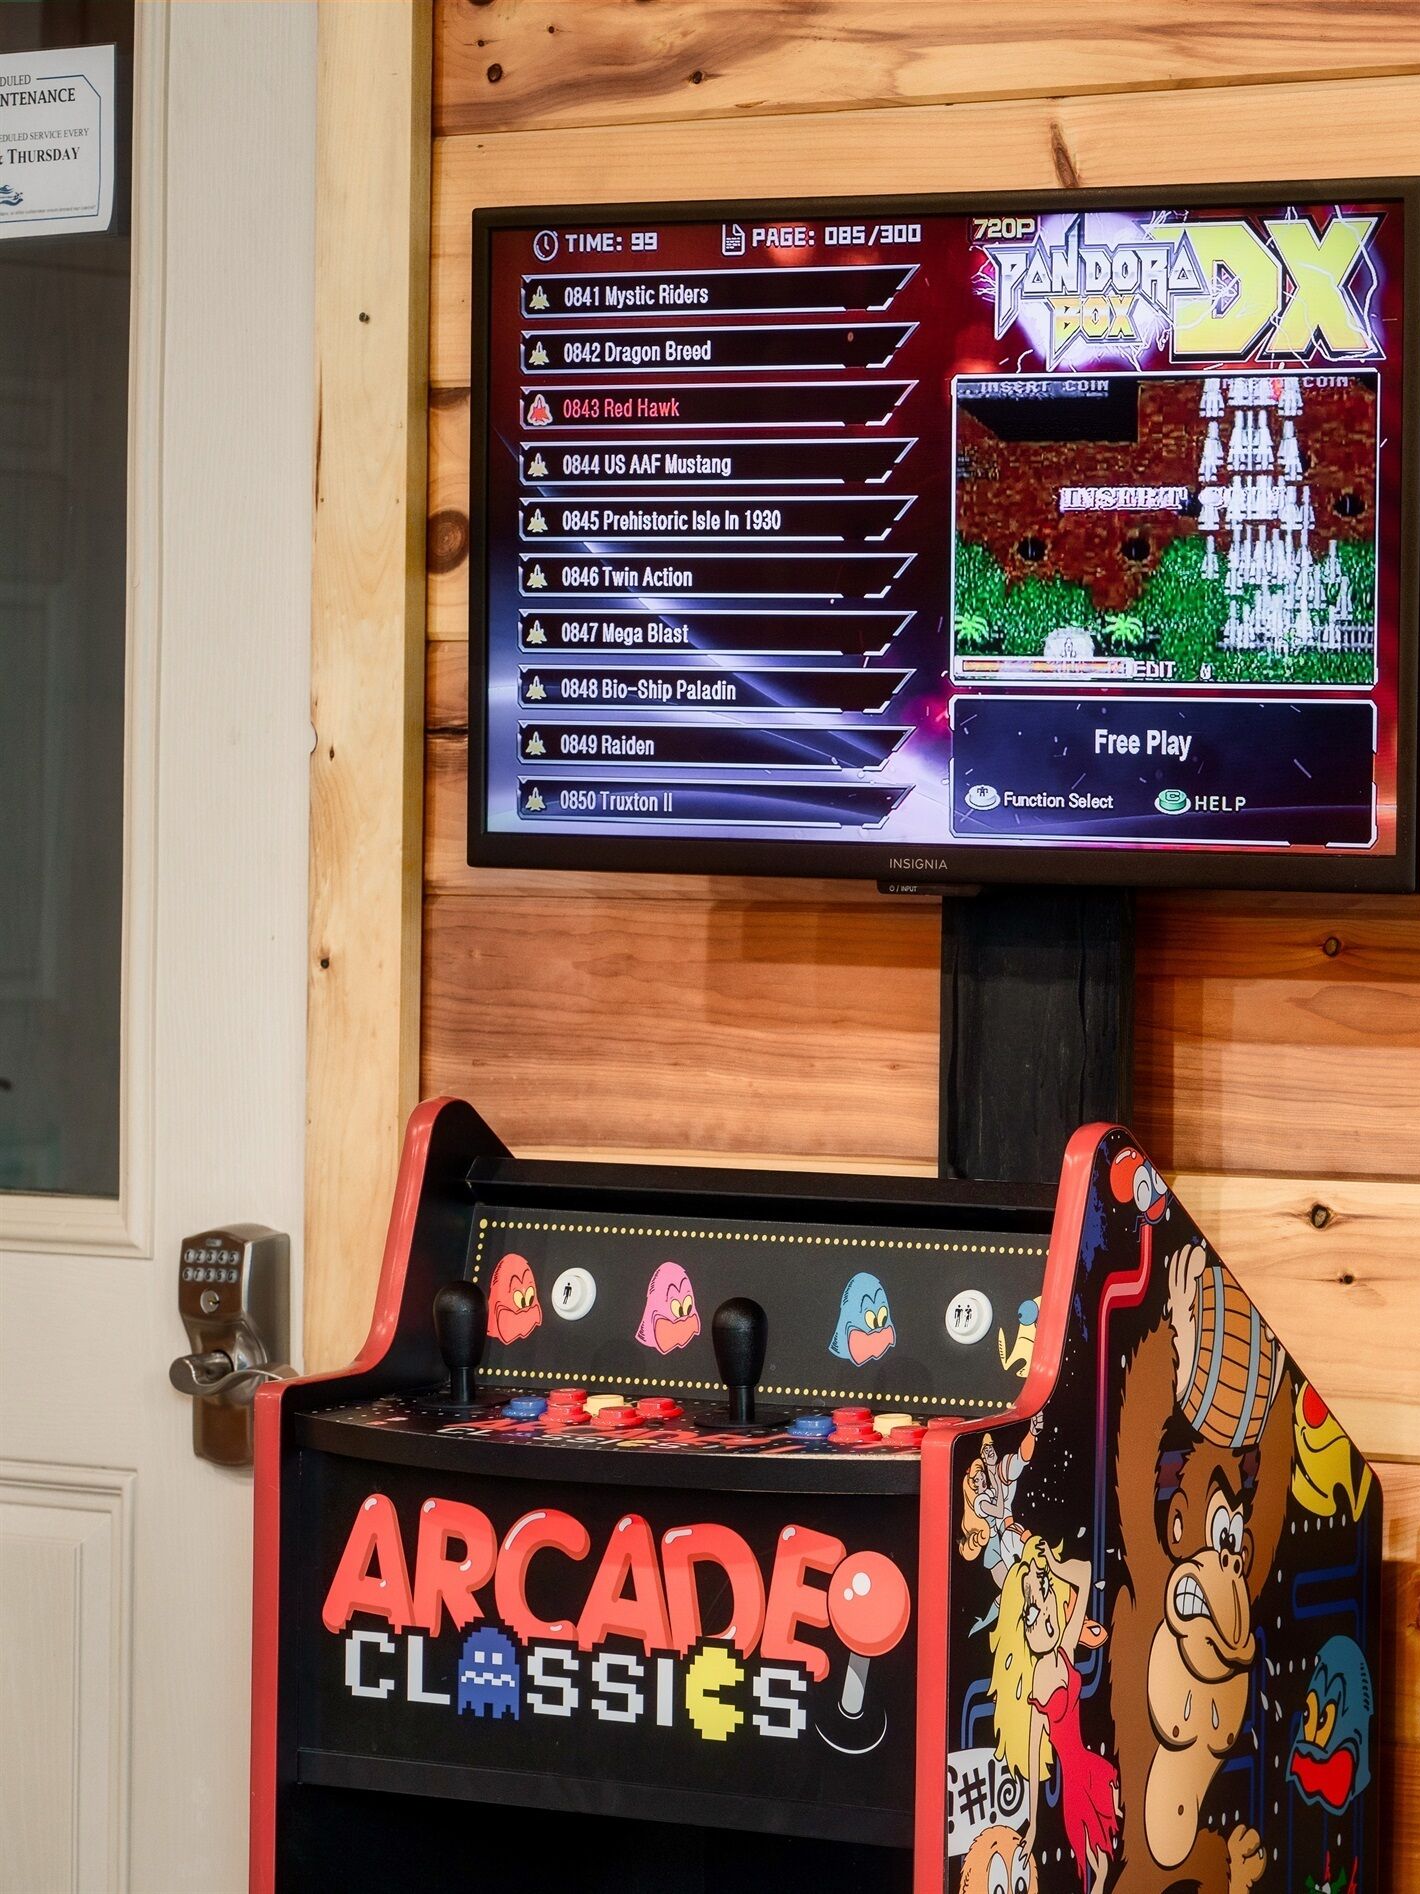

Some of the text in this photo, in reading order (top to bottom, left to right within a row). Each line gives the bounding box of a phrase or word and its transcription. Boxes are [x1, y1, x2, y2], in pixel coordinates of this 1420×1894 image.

[0, 88, 75, 107] NTENANCE
[30, 129, 62, 140] SERVICE
[64, 128, 89, 138] EVERY
[7, 147, 80, 164] THURSDAY
[752, 224, 922, 247] PAGE: 085/300
[973, 218, 1036, 239] 720P
[565, 231, 659, 252] TIME: 99
[564, 285, 709, 308] 0841 Mystic Riders
[985, 213, 1387, 362] PANDORA DX
[1047, 294, 1145, 371] BOX
[564, 340, 711, 365] 0842 Dragon Breed
[563, 398, 680, 418] 0843 Red Hawk
[562, 454, 732, 477] 0844 US AAF Mustang
[1060, 486, 1188, 511] INSERT
[562, 510, 782, 531] 0845 Prehistoric Isle In 1930
[561, 567, 693, 587] 0846 Twin Action
[561, 622, 689, 645] 0847 Mega Blast
[1133, 660, 1175, 678] EDIT
[560, 678, 736, 703] 0848 Bio-Ship Paladin
[560, 735, 655, 756] 0849 Raiden
[1094, 729, 1191, 761] Free Play
[560, 790, 673, 812] 0850 Truxton II
[1003, 792, 1114, 810] Function Select
[1195, 796, 1246, 811] HELP
[889, 858, 948, 870] INSIGNIA
[322, 1494, 846, 1682] ARCADE
